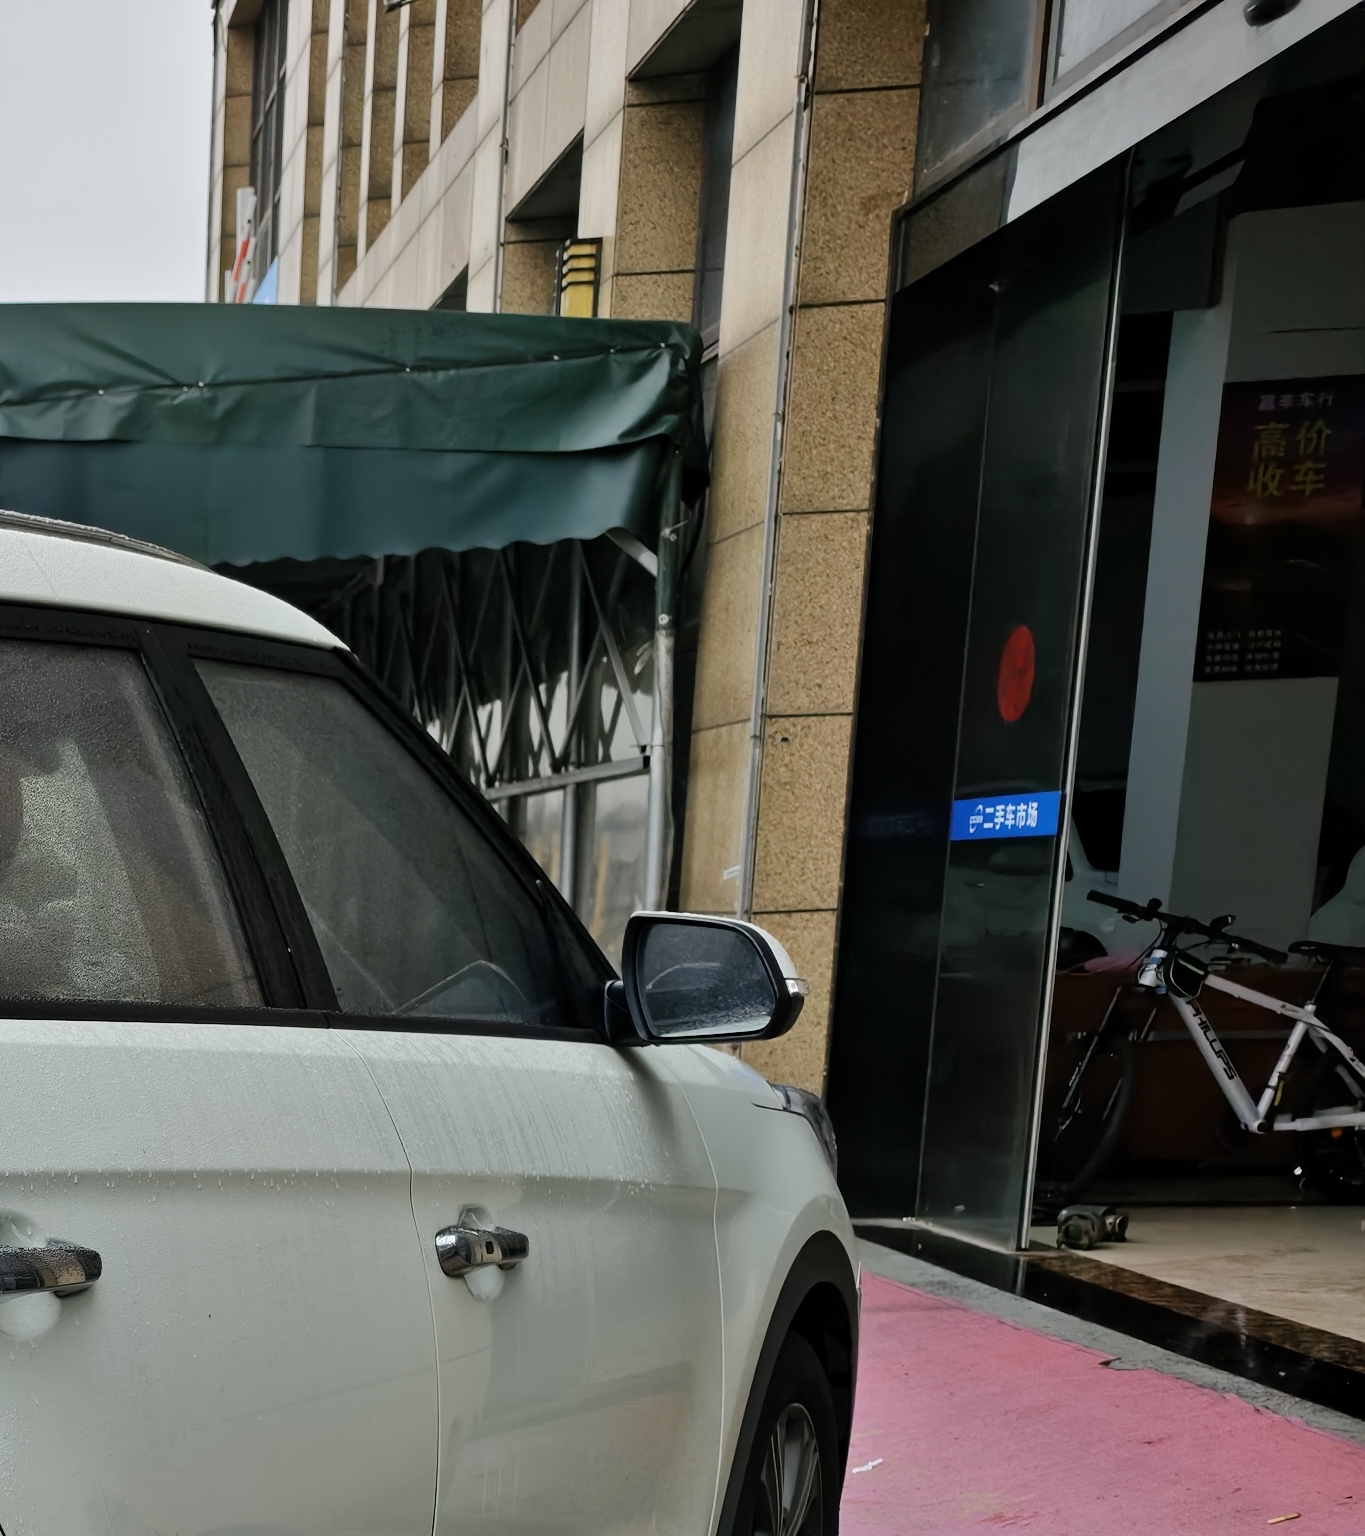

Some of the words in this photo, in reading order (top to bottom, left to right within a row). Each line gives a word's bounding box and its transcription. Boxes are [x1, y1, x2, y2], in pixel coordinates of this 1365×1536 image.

[1253, 418, 1332, 458] 高价
[1246, 461, 1327, 498] 收车
[983, 801, 1038, 831] 二手车市场
[1185, 999, 1238, 1080] PHILLIPS
